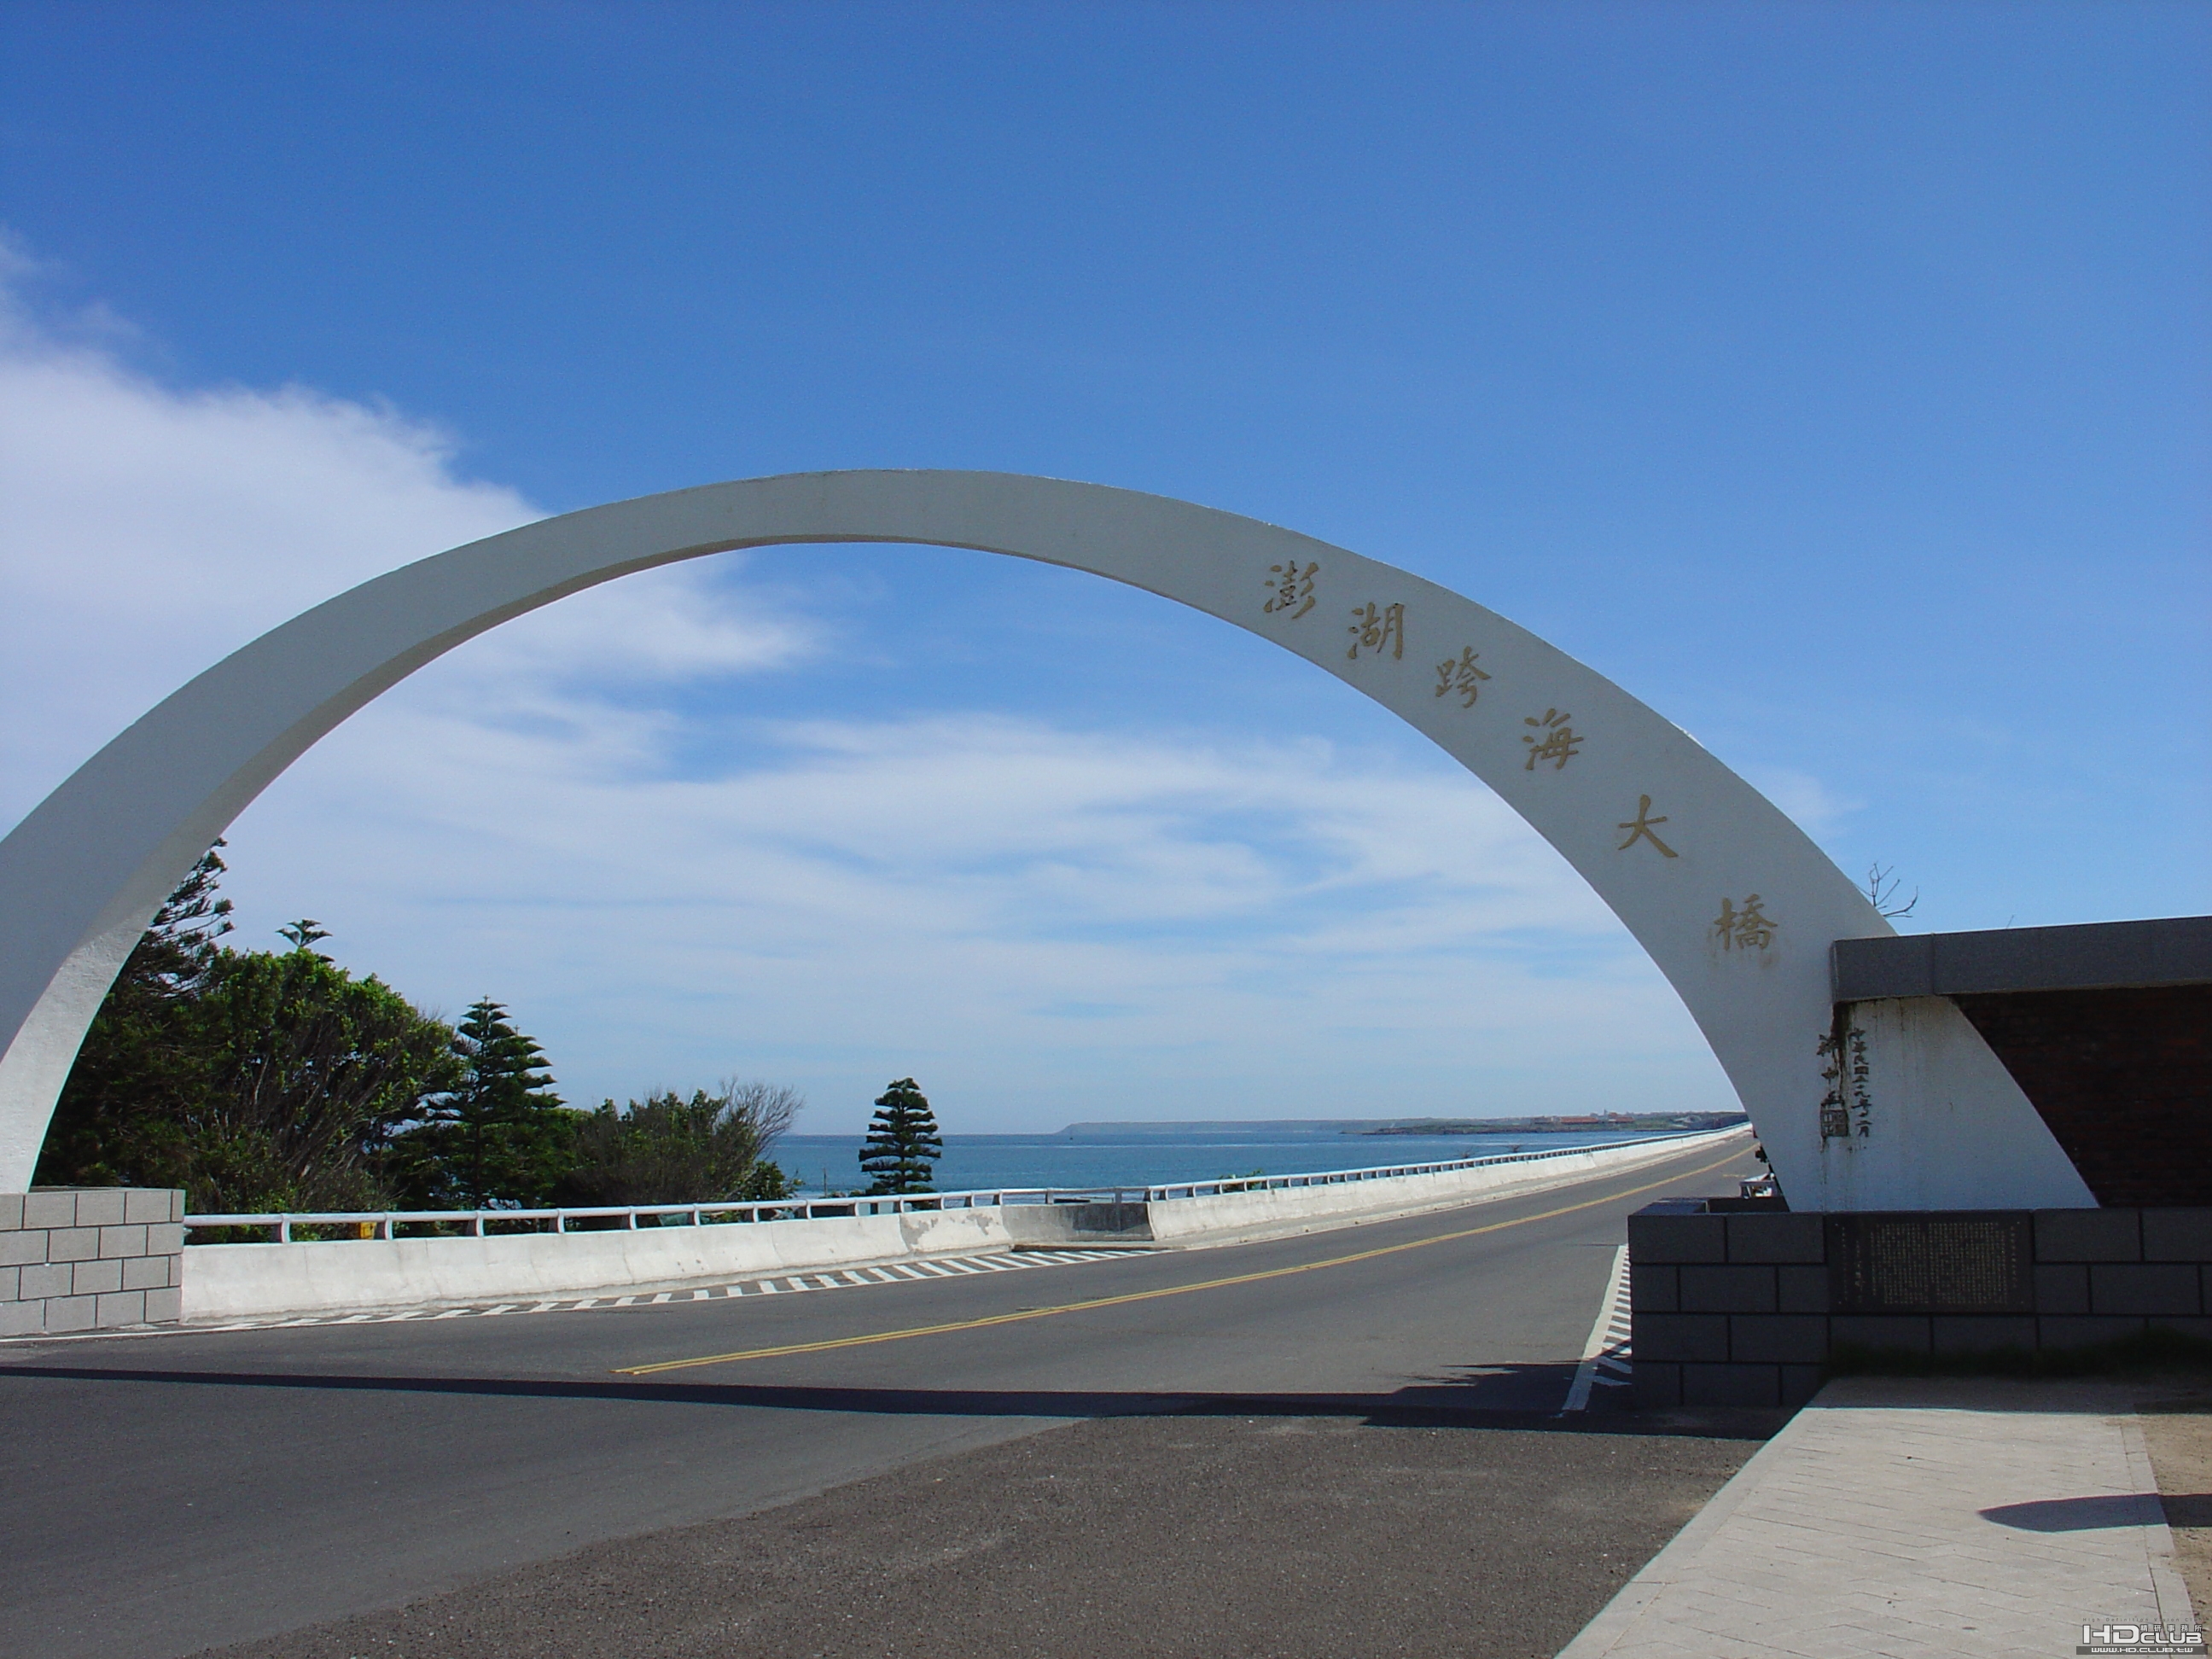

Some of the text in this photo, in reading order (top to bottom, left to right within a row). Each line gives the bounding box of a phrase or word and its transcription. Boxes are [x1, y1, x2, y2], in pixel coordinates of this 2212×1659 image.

[1264, 560, 1778, 952] 澎湖跨海大橋
